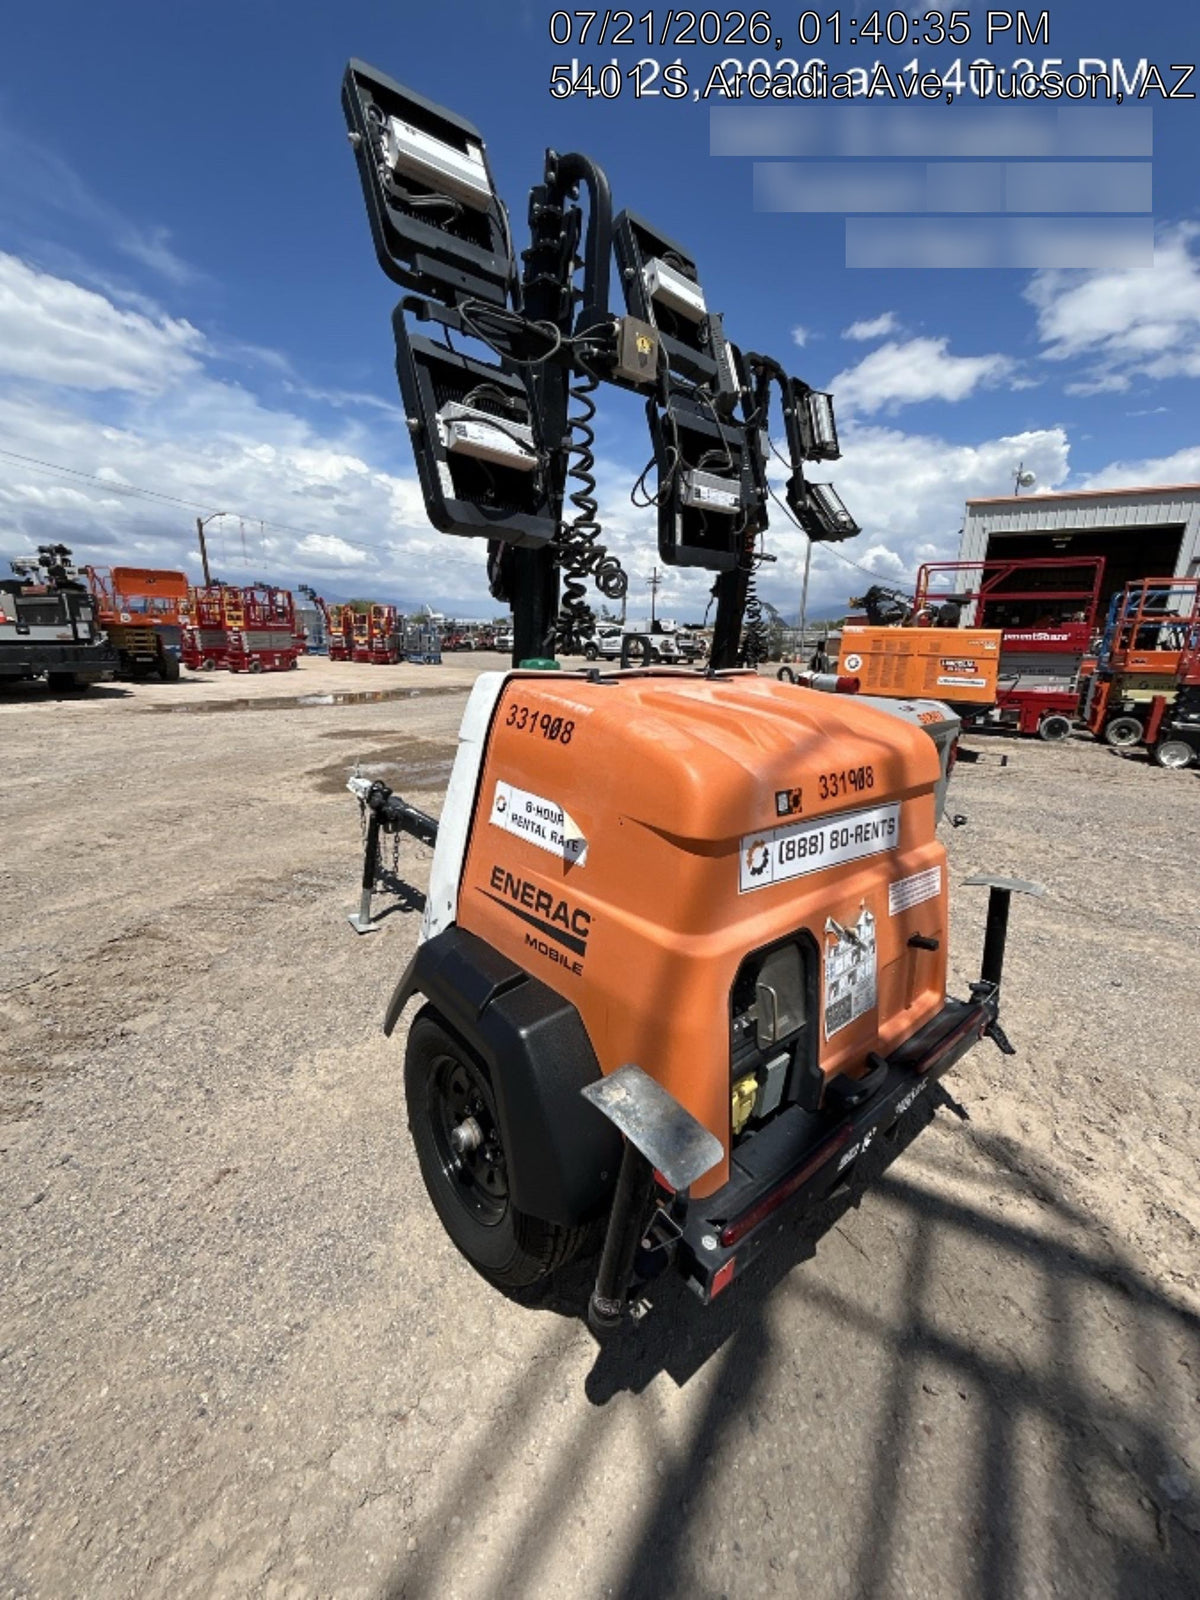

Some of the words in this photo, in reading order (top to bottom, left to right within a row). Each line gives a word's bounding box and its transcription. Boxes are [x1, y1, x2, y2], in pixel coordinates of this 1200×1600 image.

[505, 703, 576, 745] 331908
[818, 766, 875, 799] 331908
[511, 813, 547, 839] RENTAL
[550, 830, 579, 852] RATE
[526, 801, 564, 827] 6-HOUR
[778, 831, 824, 864] (888)
[830, 817, 895, 850] 80-RENTS
[490, 865, 591, 938] ENERAC
[525, 933, 584, 976] MOBILE
